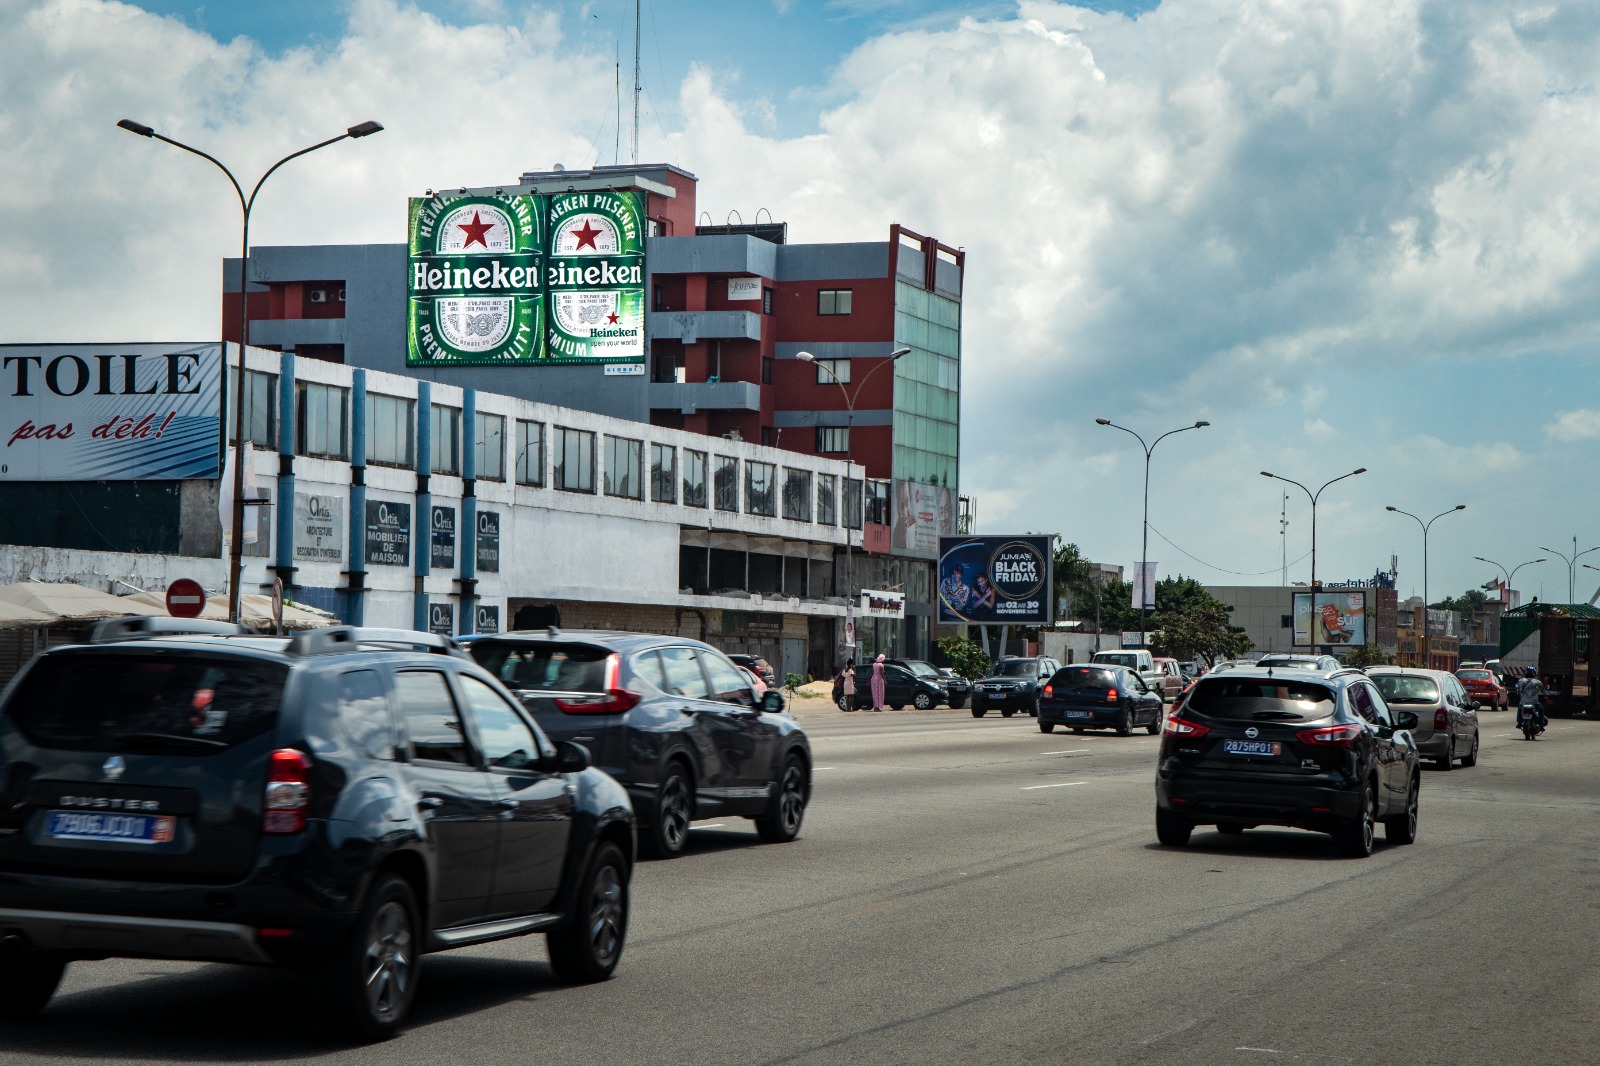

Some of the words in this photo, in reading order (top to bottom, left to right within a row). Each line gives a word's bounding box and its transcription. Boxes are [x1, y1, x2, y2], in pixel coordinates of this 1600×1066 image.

[593, 195, 636, 240] PILSENER
[413, 261, 538, 290] Heineken
[590, 327, 638, 338] Heineken
[620, 338, 638, 346] world
[4, 354, 202, 397] TOILE
[7, 420, 76, 447] pas
[91, 411, 177, 440] dêh!
[306, 525, 333, 538] ARCHITECTURE
[367, 530, 408, 544] MOBILIER
[382, 542, 395, 553] DE
[370, 551, 404, 564] MAISON
[1000, 553, 1026, 561] JUMIA
[995, 561, 1036, 573] BLACK
[1005, 601, 1018, 609] 02
[1026, 601, 1039, 609] 30
[59, 795, 160, 811] DUSTER
